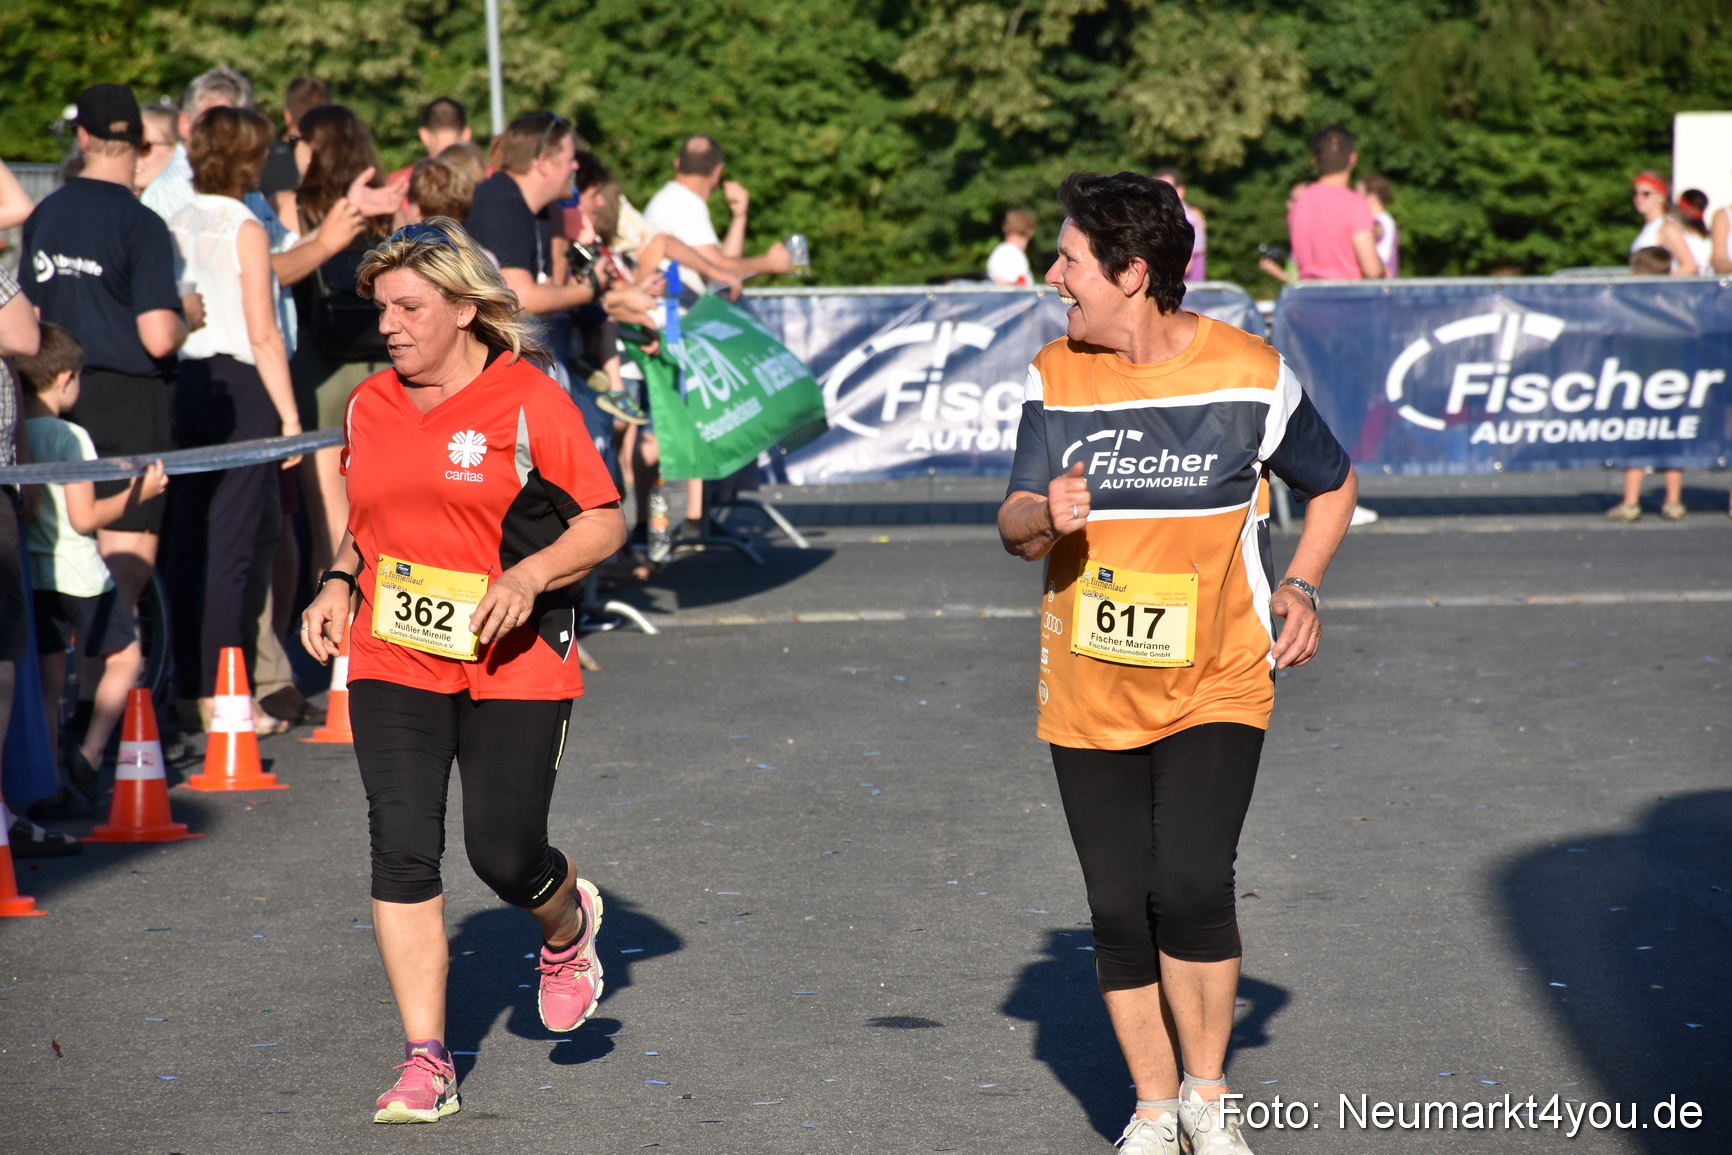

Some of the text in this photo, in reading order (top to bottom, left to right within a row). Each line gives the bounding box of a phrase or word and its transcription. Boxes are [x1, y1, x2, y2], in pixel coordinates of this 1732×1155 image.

[1446, 357, 1725, 414] Fischer
[1470, 414, 1700, 444] AUTOMOBILE
[1088, 448, 1218, 475] Fischer
[445, 469, 484, 483] caritas
[1099, 475, 1209, 490] AUTOMOBILE
[389, 571, 424, 586] firmenlauf
[1091, 577, 1128, 593] firmenlauf
[1082, 588, 1110, 602] walken
[395, 592, 455, 632] 362
[1096, 600, 1166, 639] 617
[389, 628, 443, 648] Caritas-Sozialstation
[444, 642, 455, 650] e.V.
[394, 621, 452, 642] Nüßler Mireille
[1090, 632, 1171, 651] Fischer Marianne
[1089, 641, 1110, 652] Fischer
[1111, 647, 1148, 657] Automobile
